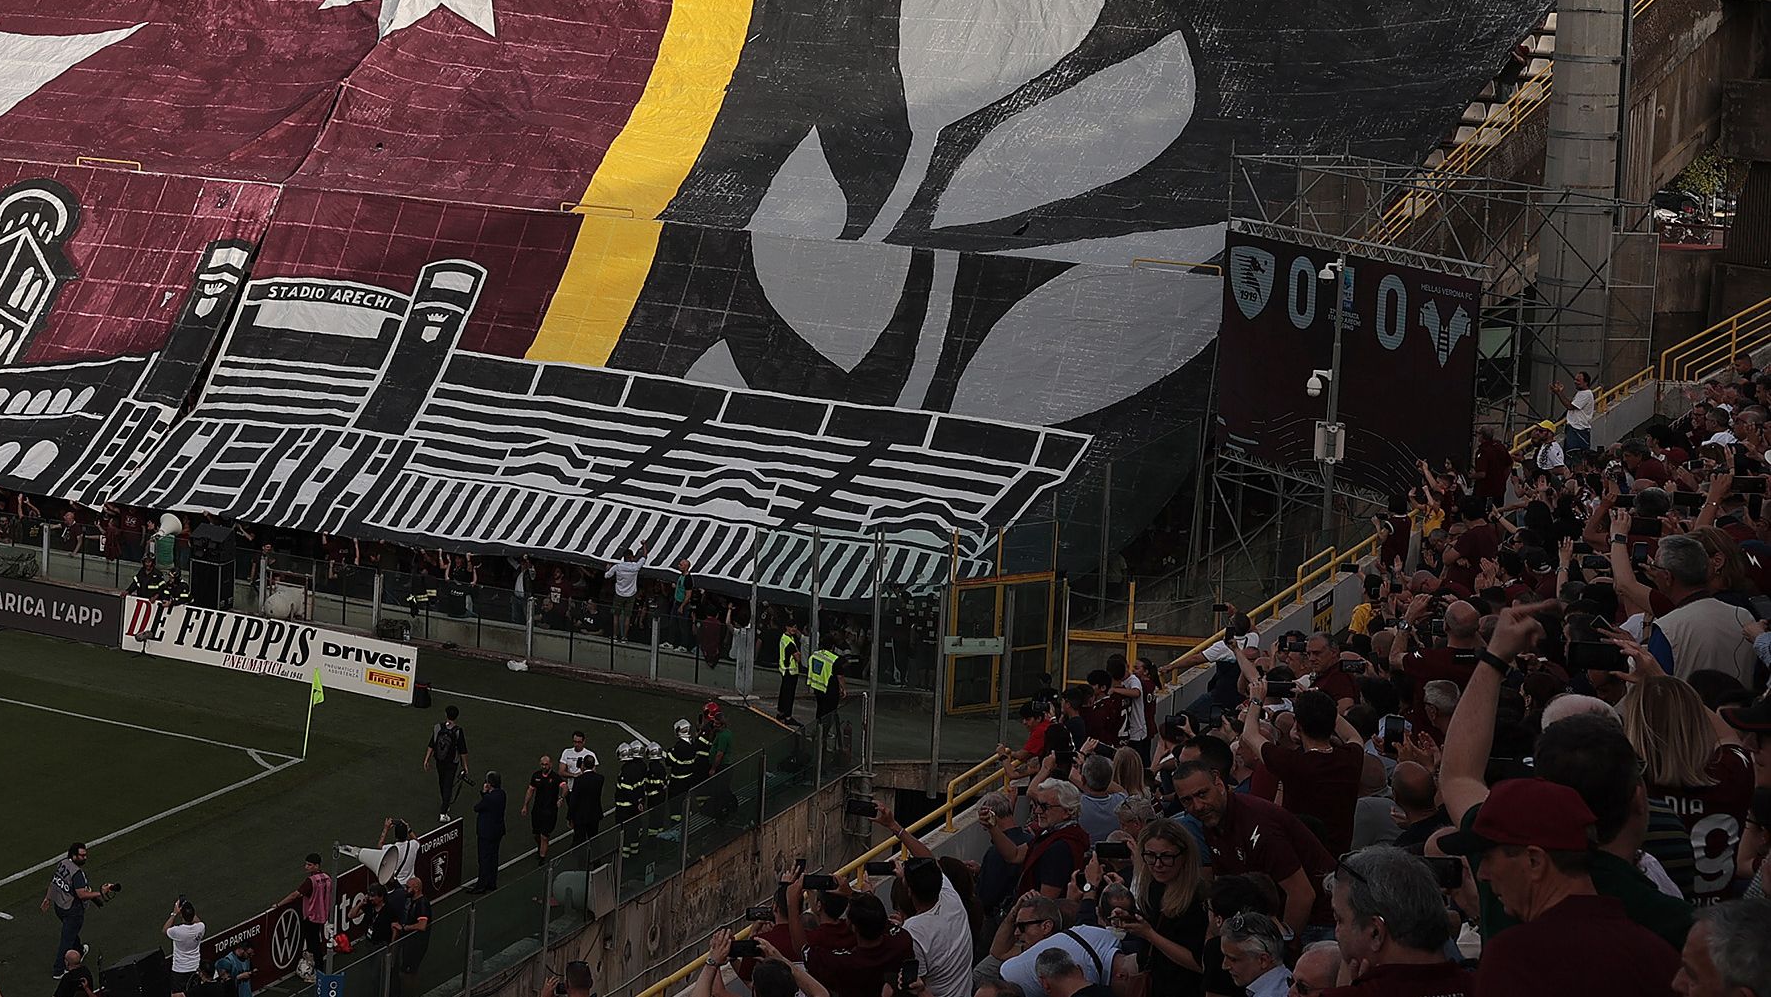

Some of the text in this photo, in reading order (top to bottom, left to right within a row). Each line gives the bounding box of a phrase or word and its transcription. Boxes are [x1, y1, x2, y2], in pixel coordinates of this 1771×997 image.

[267, 285, 394, 309] STADIO ARECHI
[1239, 289, 1257, 303] 1919
[1288, 255, 1316, 330] 0
[1420, 283, 1442, 294] HELLAS
[1441, 287, 1465, 299] VERONA
[1376, 274, 1408, 350] 0
[125, 598, 318, 668] DE FILIPPIS
[222, 654, 283, 675] PNEUMATICI
[368, 671, 406, 688] PIRELLI
[421, 828, 459, 854] TOP PARTNER
[214, 924, 261, 954] TOP PARTNER
